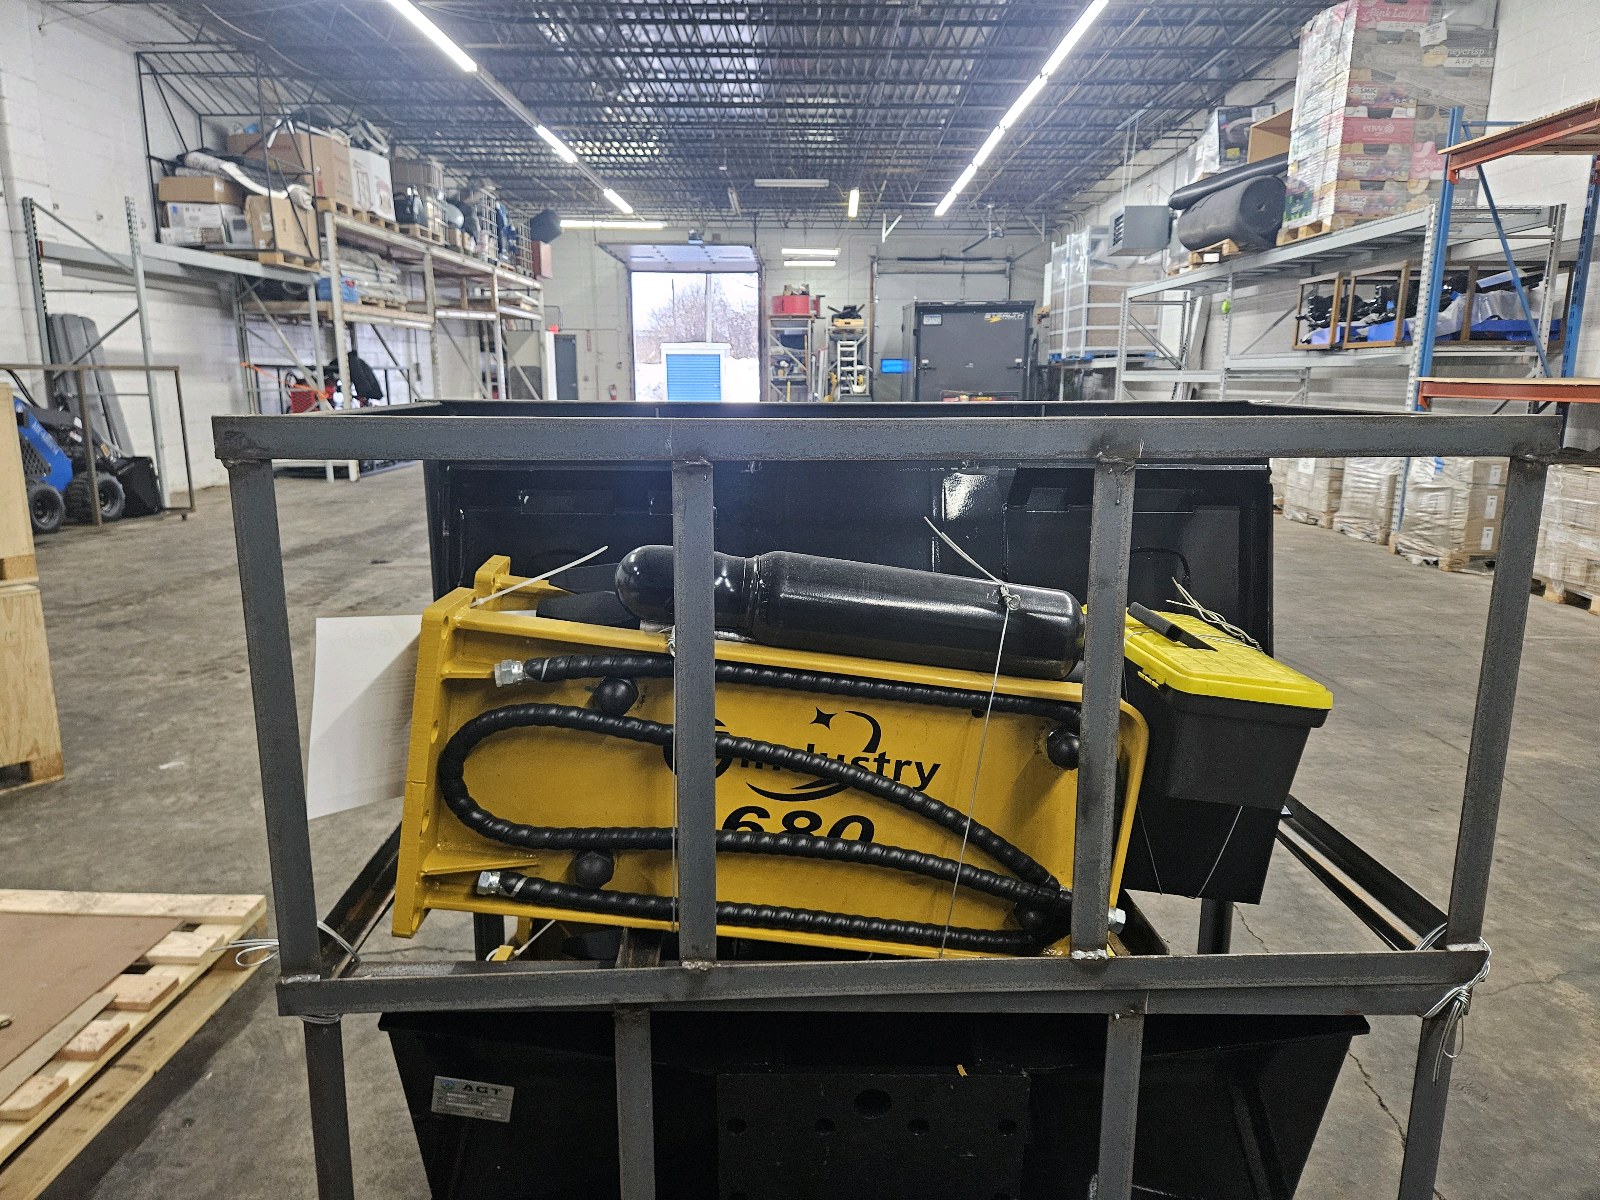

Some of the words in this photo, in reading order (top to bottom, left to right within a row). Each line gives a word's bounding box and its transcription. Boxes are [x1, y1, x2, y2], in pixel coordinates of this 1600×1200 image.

[1369, 7, 1392, 19] Pink
[1393, 9, 1417, 22] Lady
[722, 805, 875, 843] 680
[463, 1084, 502, 1096] AGT
